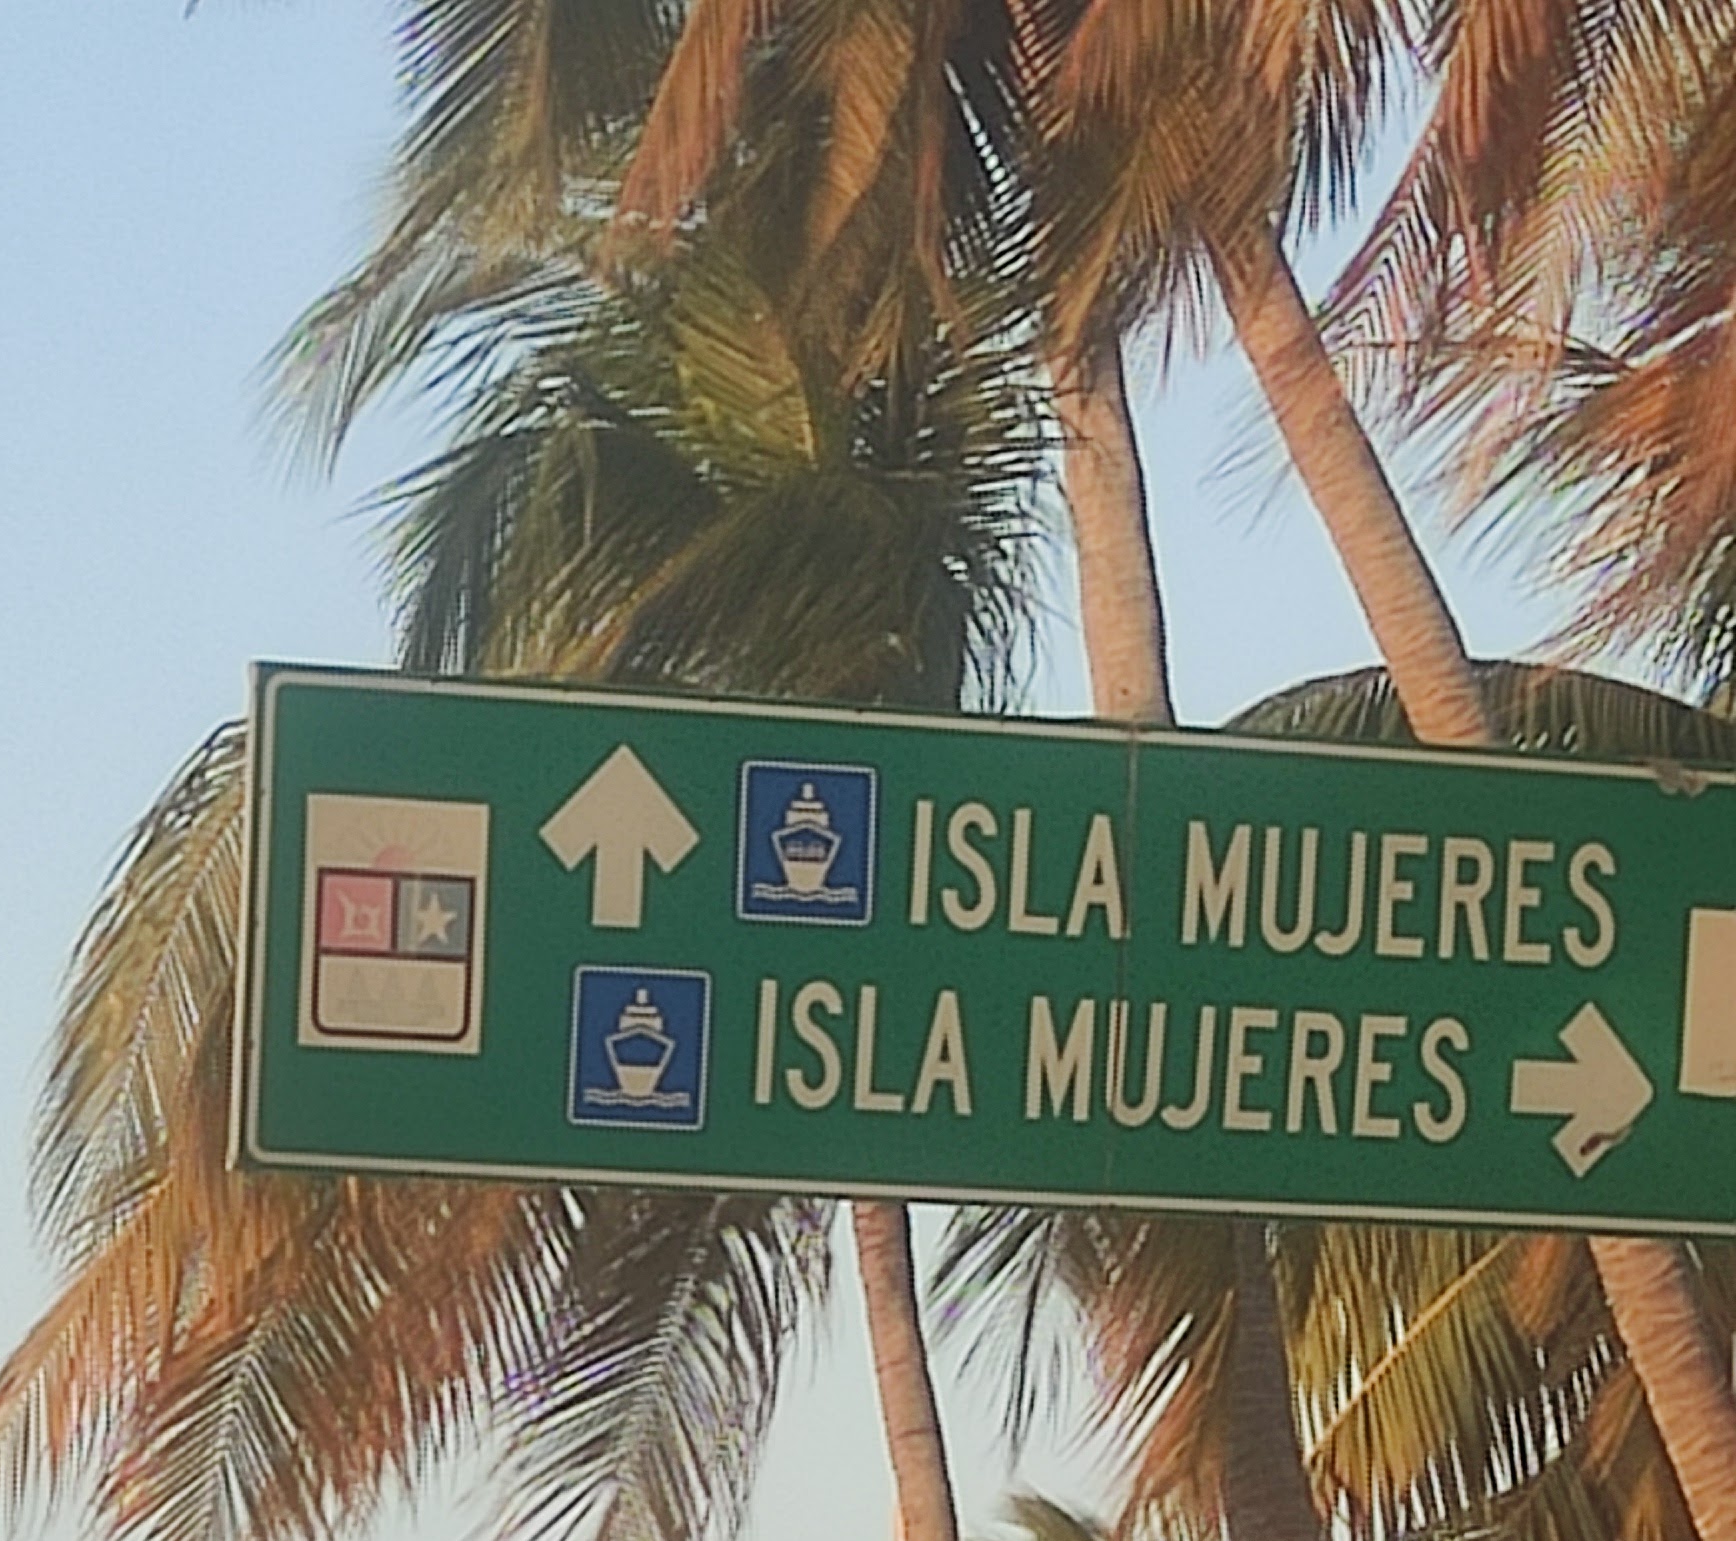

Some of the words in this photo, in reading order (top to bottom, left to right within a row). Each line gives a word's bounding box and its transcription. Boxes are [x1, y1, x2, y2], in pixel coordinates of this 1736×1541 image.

[910, 799, 1131, 940] ISLA
[1181, 820, 1616, 968] MUJERES
[755, 980, 972, 1116] ISLA
[1025, 995, 1470, 1143] MUJERES
